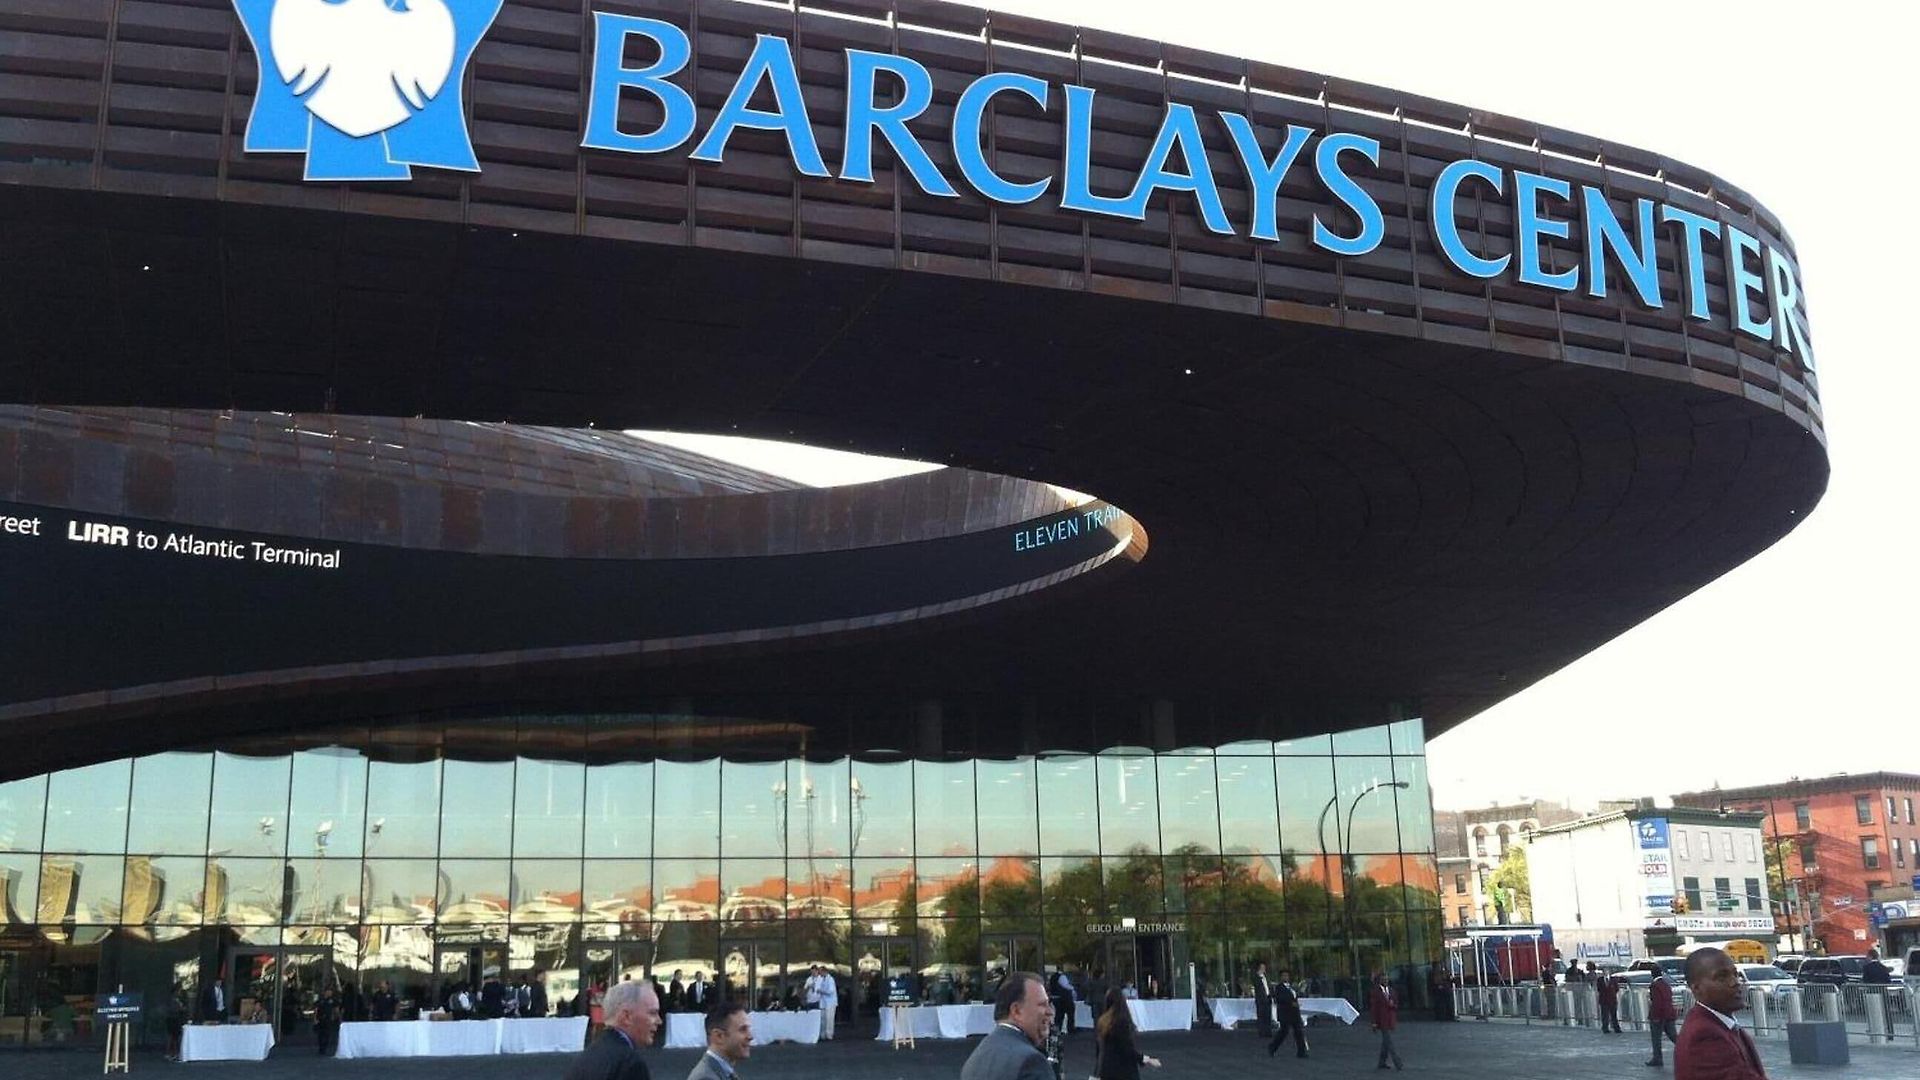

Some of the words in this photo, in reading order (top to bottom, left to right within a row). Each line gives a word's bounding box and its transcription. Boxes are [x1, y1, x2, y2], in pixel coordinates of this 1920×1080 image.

[580, 10, 1385, 255] BARCLAYS
[1433, 159, 1815, 371] CENTER
[68, 520, 130, 547] LIRR
[136, 530, 159, 551] to
[163, 532, 245, 560] Atlantic
[251, 541, 341, 569] Terminal
[1015, 517, 1079, 552] ELEVEN
[1086, 923, 1112, 933] GEICO
[1138, 922, 1185, 933] ENTRANCE
